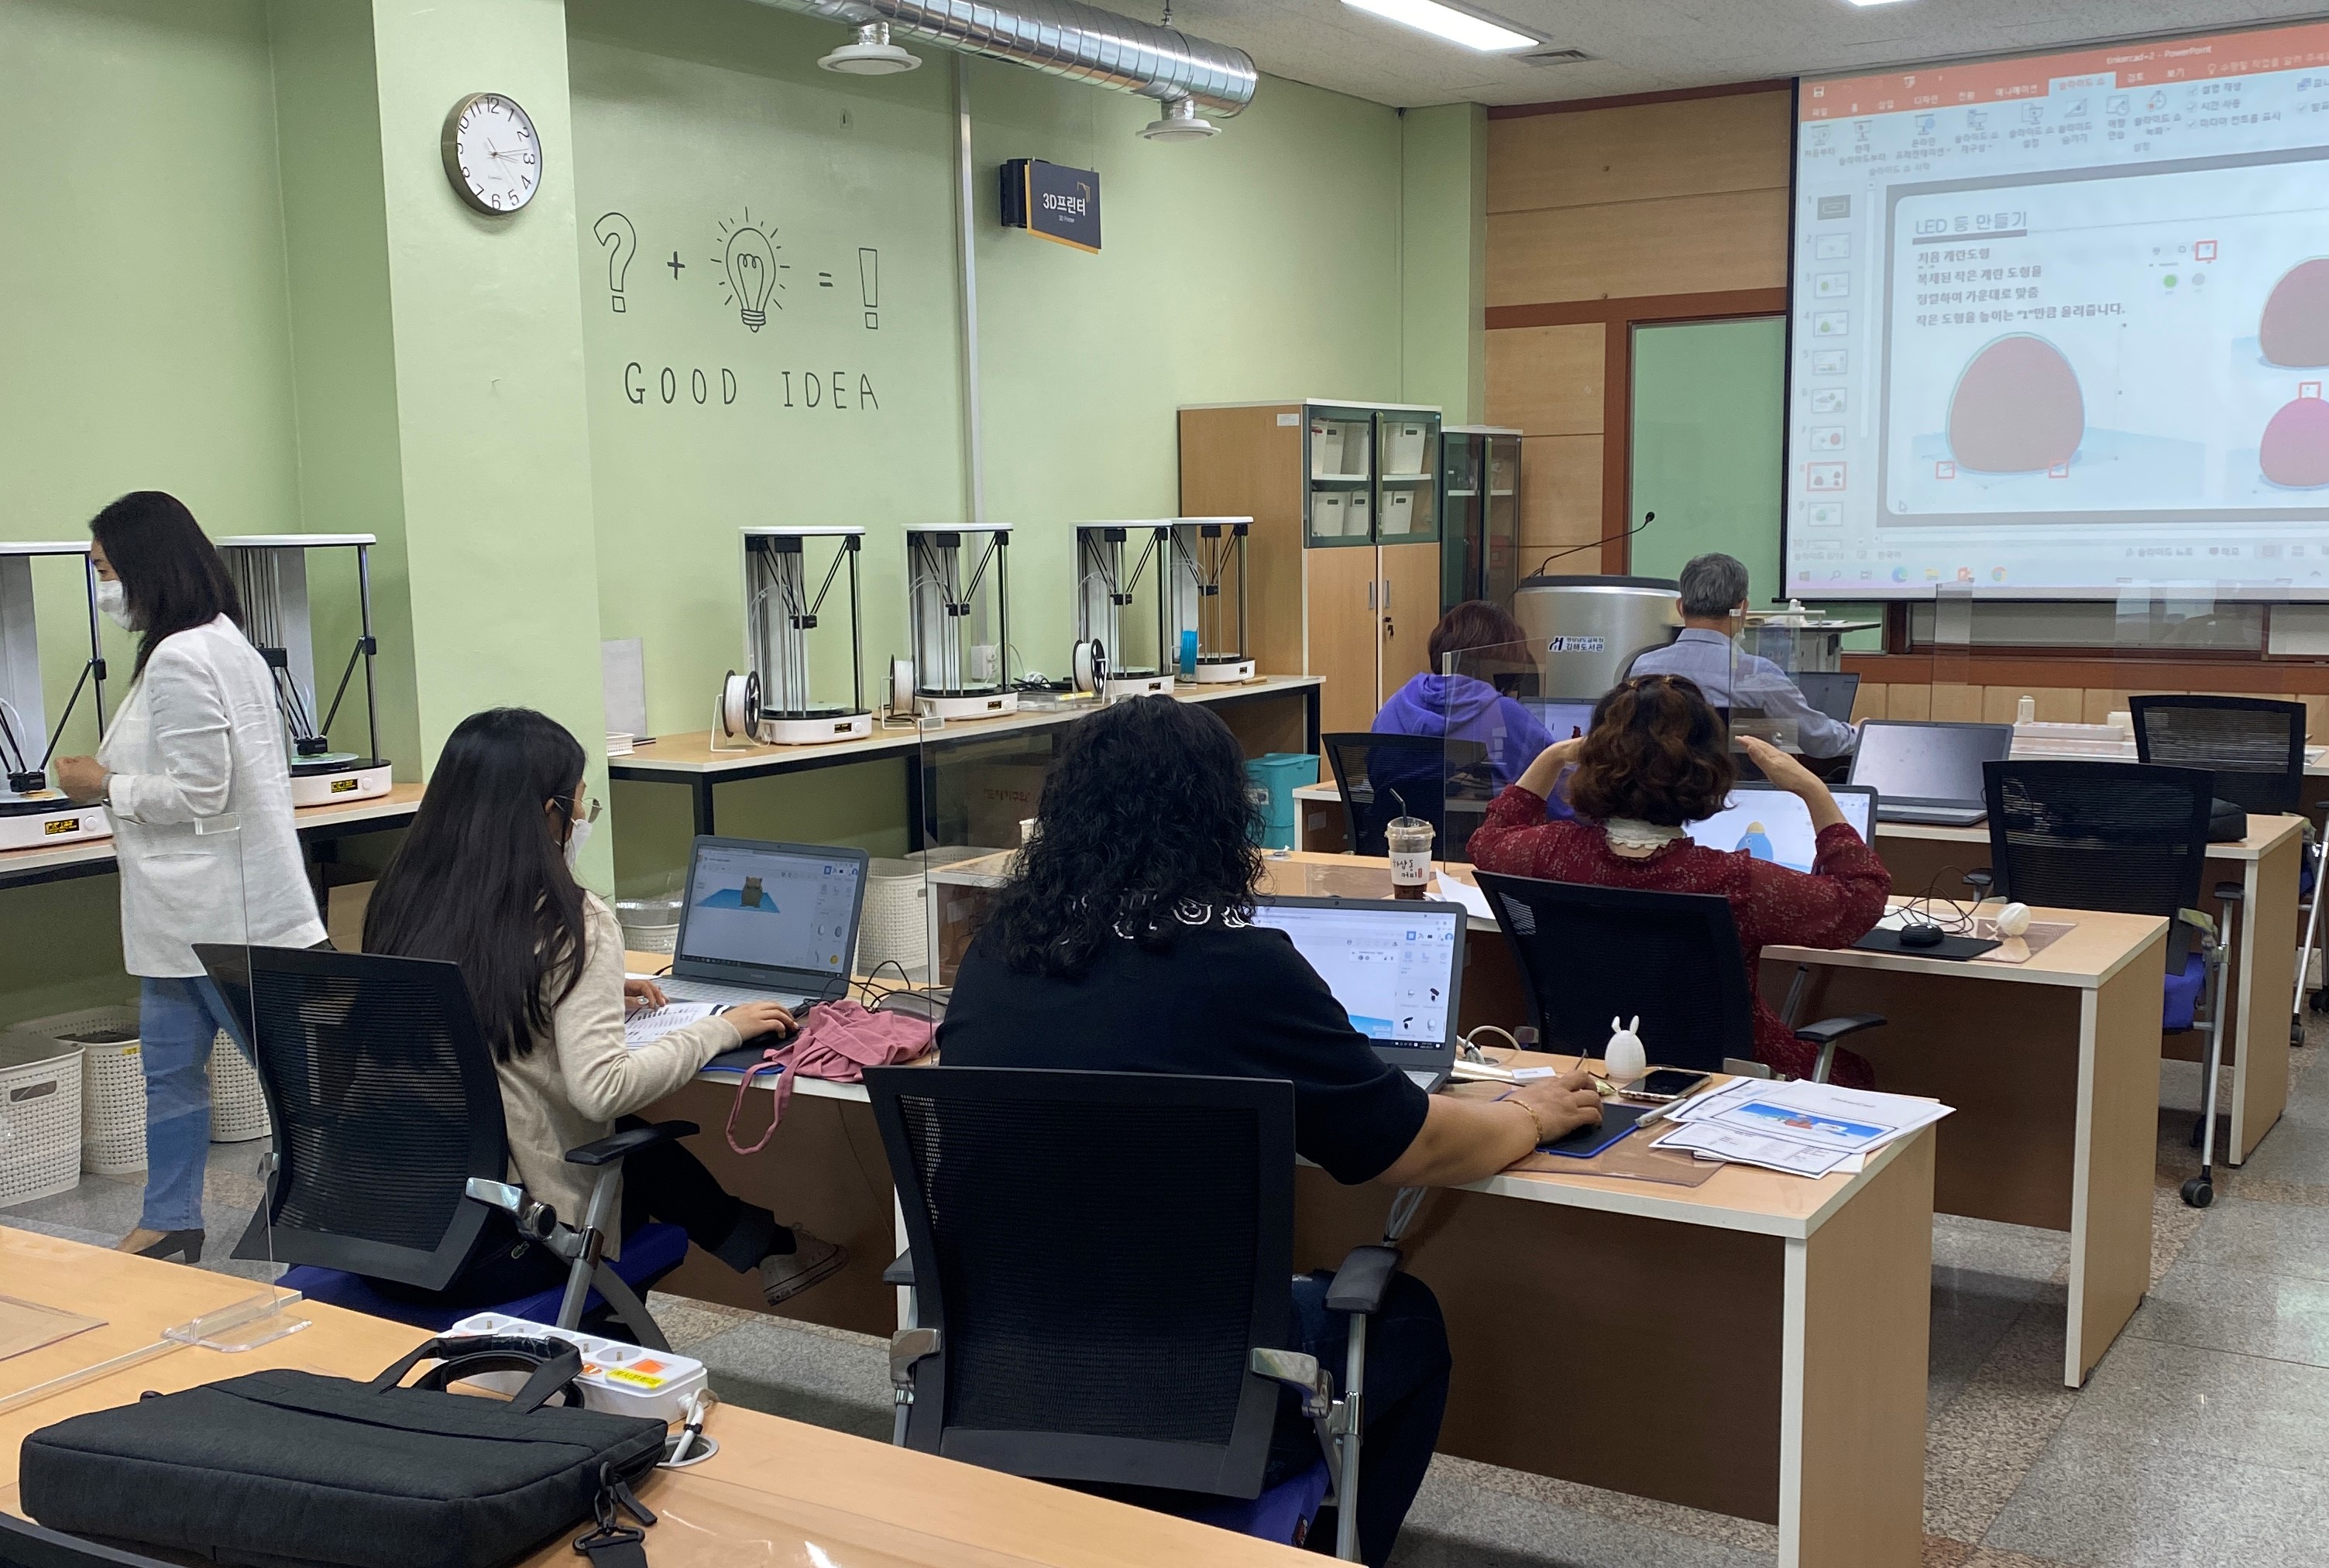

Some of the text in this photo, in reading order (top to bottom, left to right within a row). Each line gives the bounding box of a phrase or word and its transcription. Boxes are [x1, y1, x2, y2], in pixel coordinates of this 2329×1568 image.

[2165, 46, 2211, 58] PowerPoint
[469, 101, 482, 118] 11
[486, 97, 500, 115] 12
[507, 108, 514, 122] 1
[458, 115, 469, 135] 10
[517, 126, 530, 142] 2
[523, 153, 535, 165] 3
[476, 183, 485, 197] 7
[520, 174, 531, 190] 4
[492, 194, 501, 211] 6
[507, 189, 520, 207] 5
[1043, 193, 1086, 216] 3D프린터
[1915, 211, 2028, 235] LED 등 만들기
[1979, 309, 2014, 323] 높이는
[624, 362, 879, 410] GOOD IDEA
[1566, 643, 1604, 652] 김해도서관
